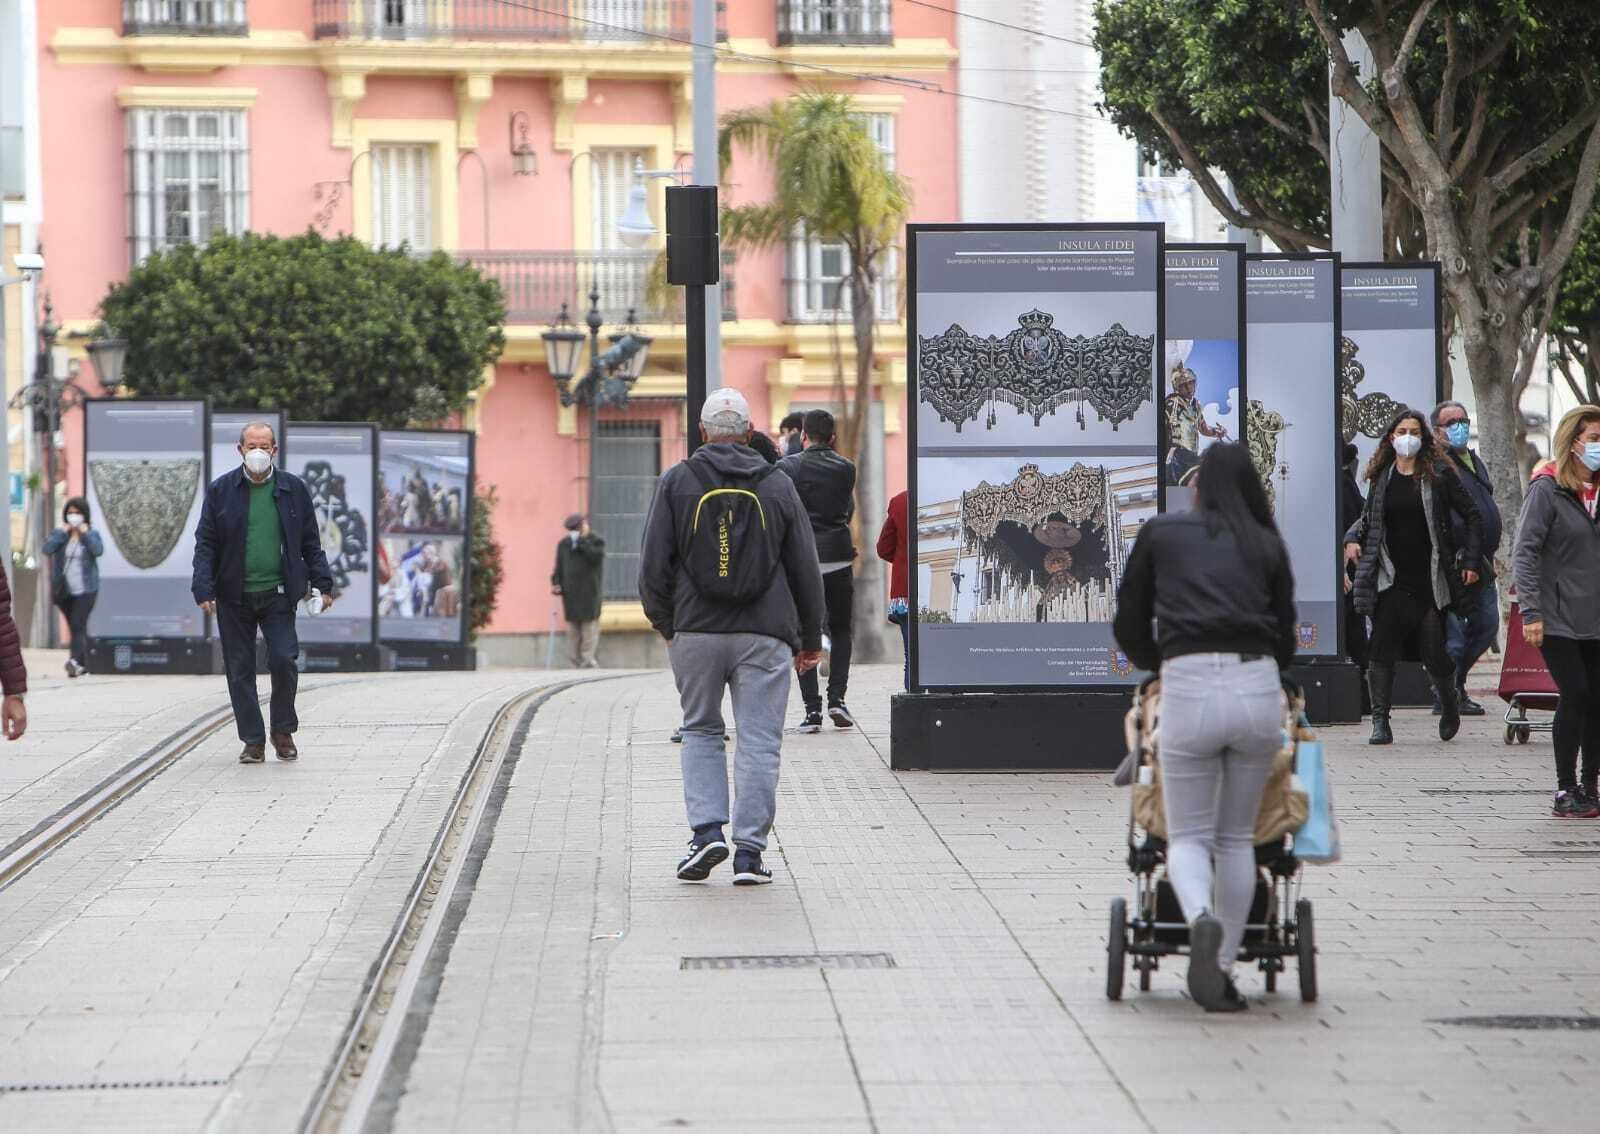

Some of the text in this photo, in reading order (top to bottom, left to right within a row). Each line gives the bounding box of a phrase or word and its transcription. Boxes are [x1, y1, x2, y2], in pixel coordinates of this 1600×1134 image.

[1059, 239, 1135, 250] INSULA FIDEI
[1167, 257, 1219, 267] ULA FIDEI
[1248, 266, 1315, 276] INSULA FIDEI
[1353, 277, 1389, 286] INSULA
[719, 517, 729, 577] SKECHERS
